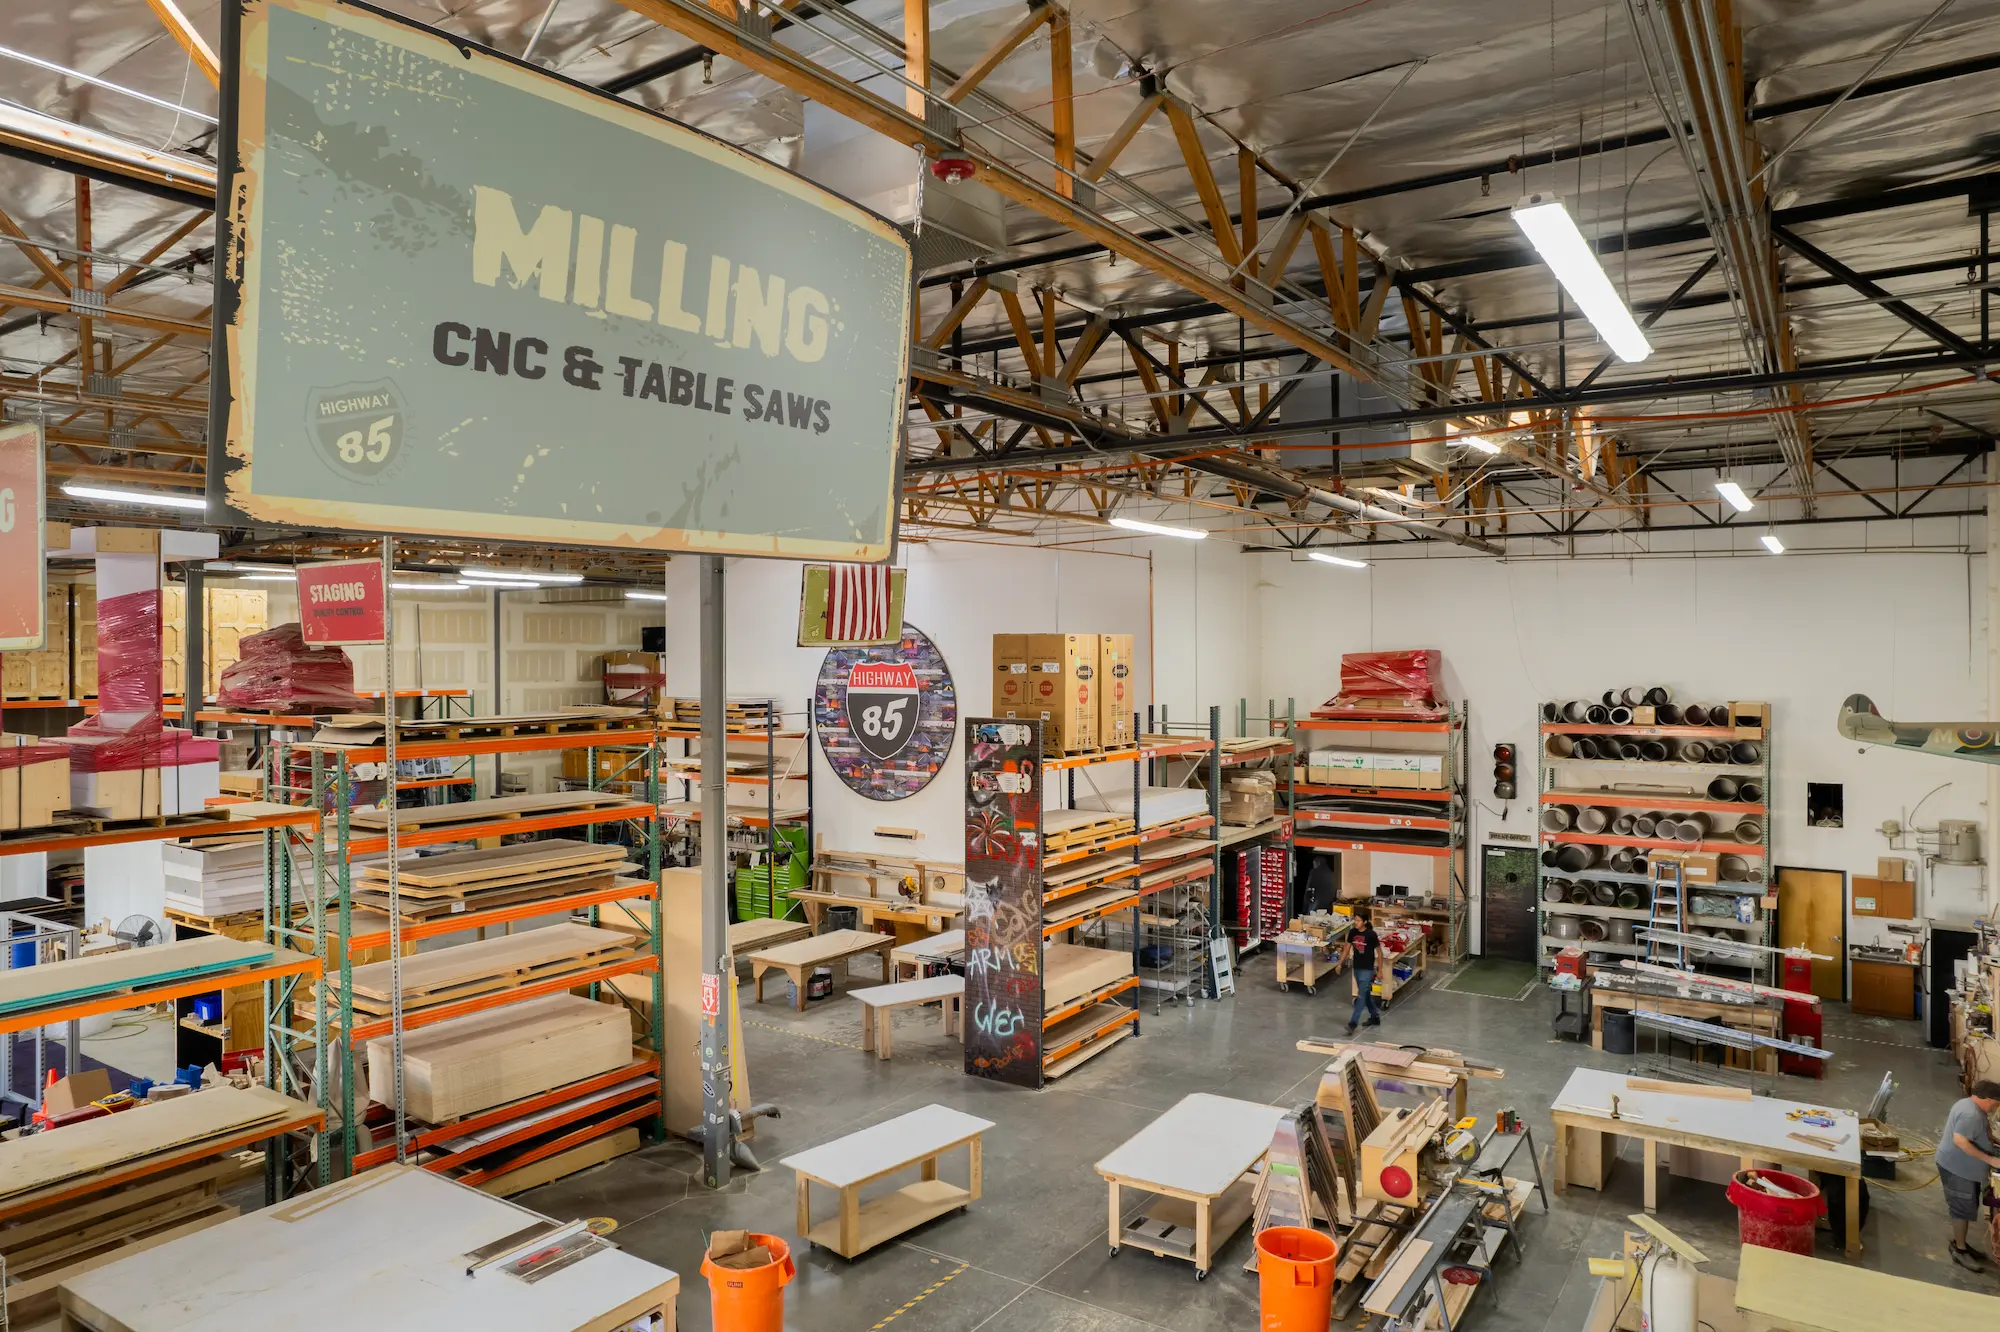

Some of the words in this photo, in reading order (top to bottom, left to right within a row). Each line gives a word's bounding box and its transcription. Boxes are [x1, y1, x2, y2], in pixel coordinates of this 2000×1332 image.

[471, 184, 832, 364] MILLING
[432, 320, 548, 381] CNC
[562, 345, 604, 392] &
[614, 354, 735, 419] TABLE
[742, 383, 832, 436] SAWS
[320, 393, 390, 416] HIGHWAY
[336, 415, 395, 464] 85
[309, 581, 366, 605] STAGING
[853, 671, 912, 686] HIGHWAY
[1004, 684, 1017, 692] STOP
[1040, 684, 1053, 692] STOP
[862, 697, 909, 741] 85
